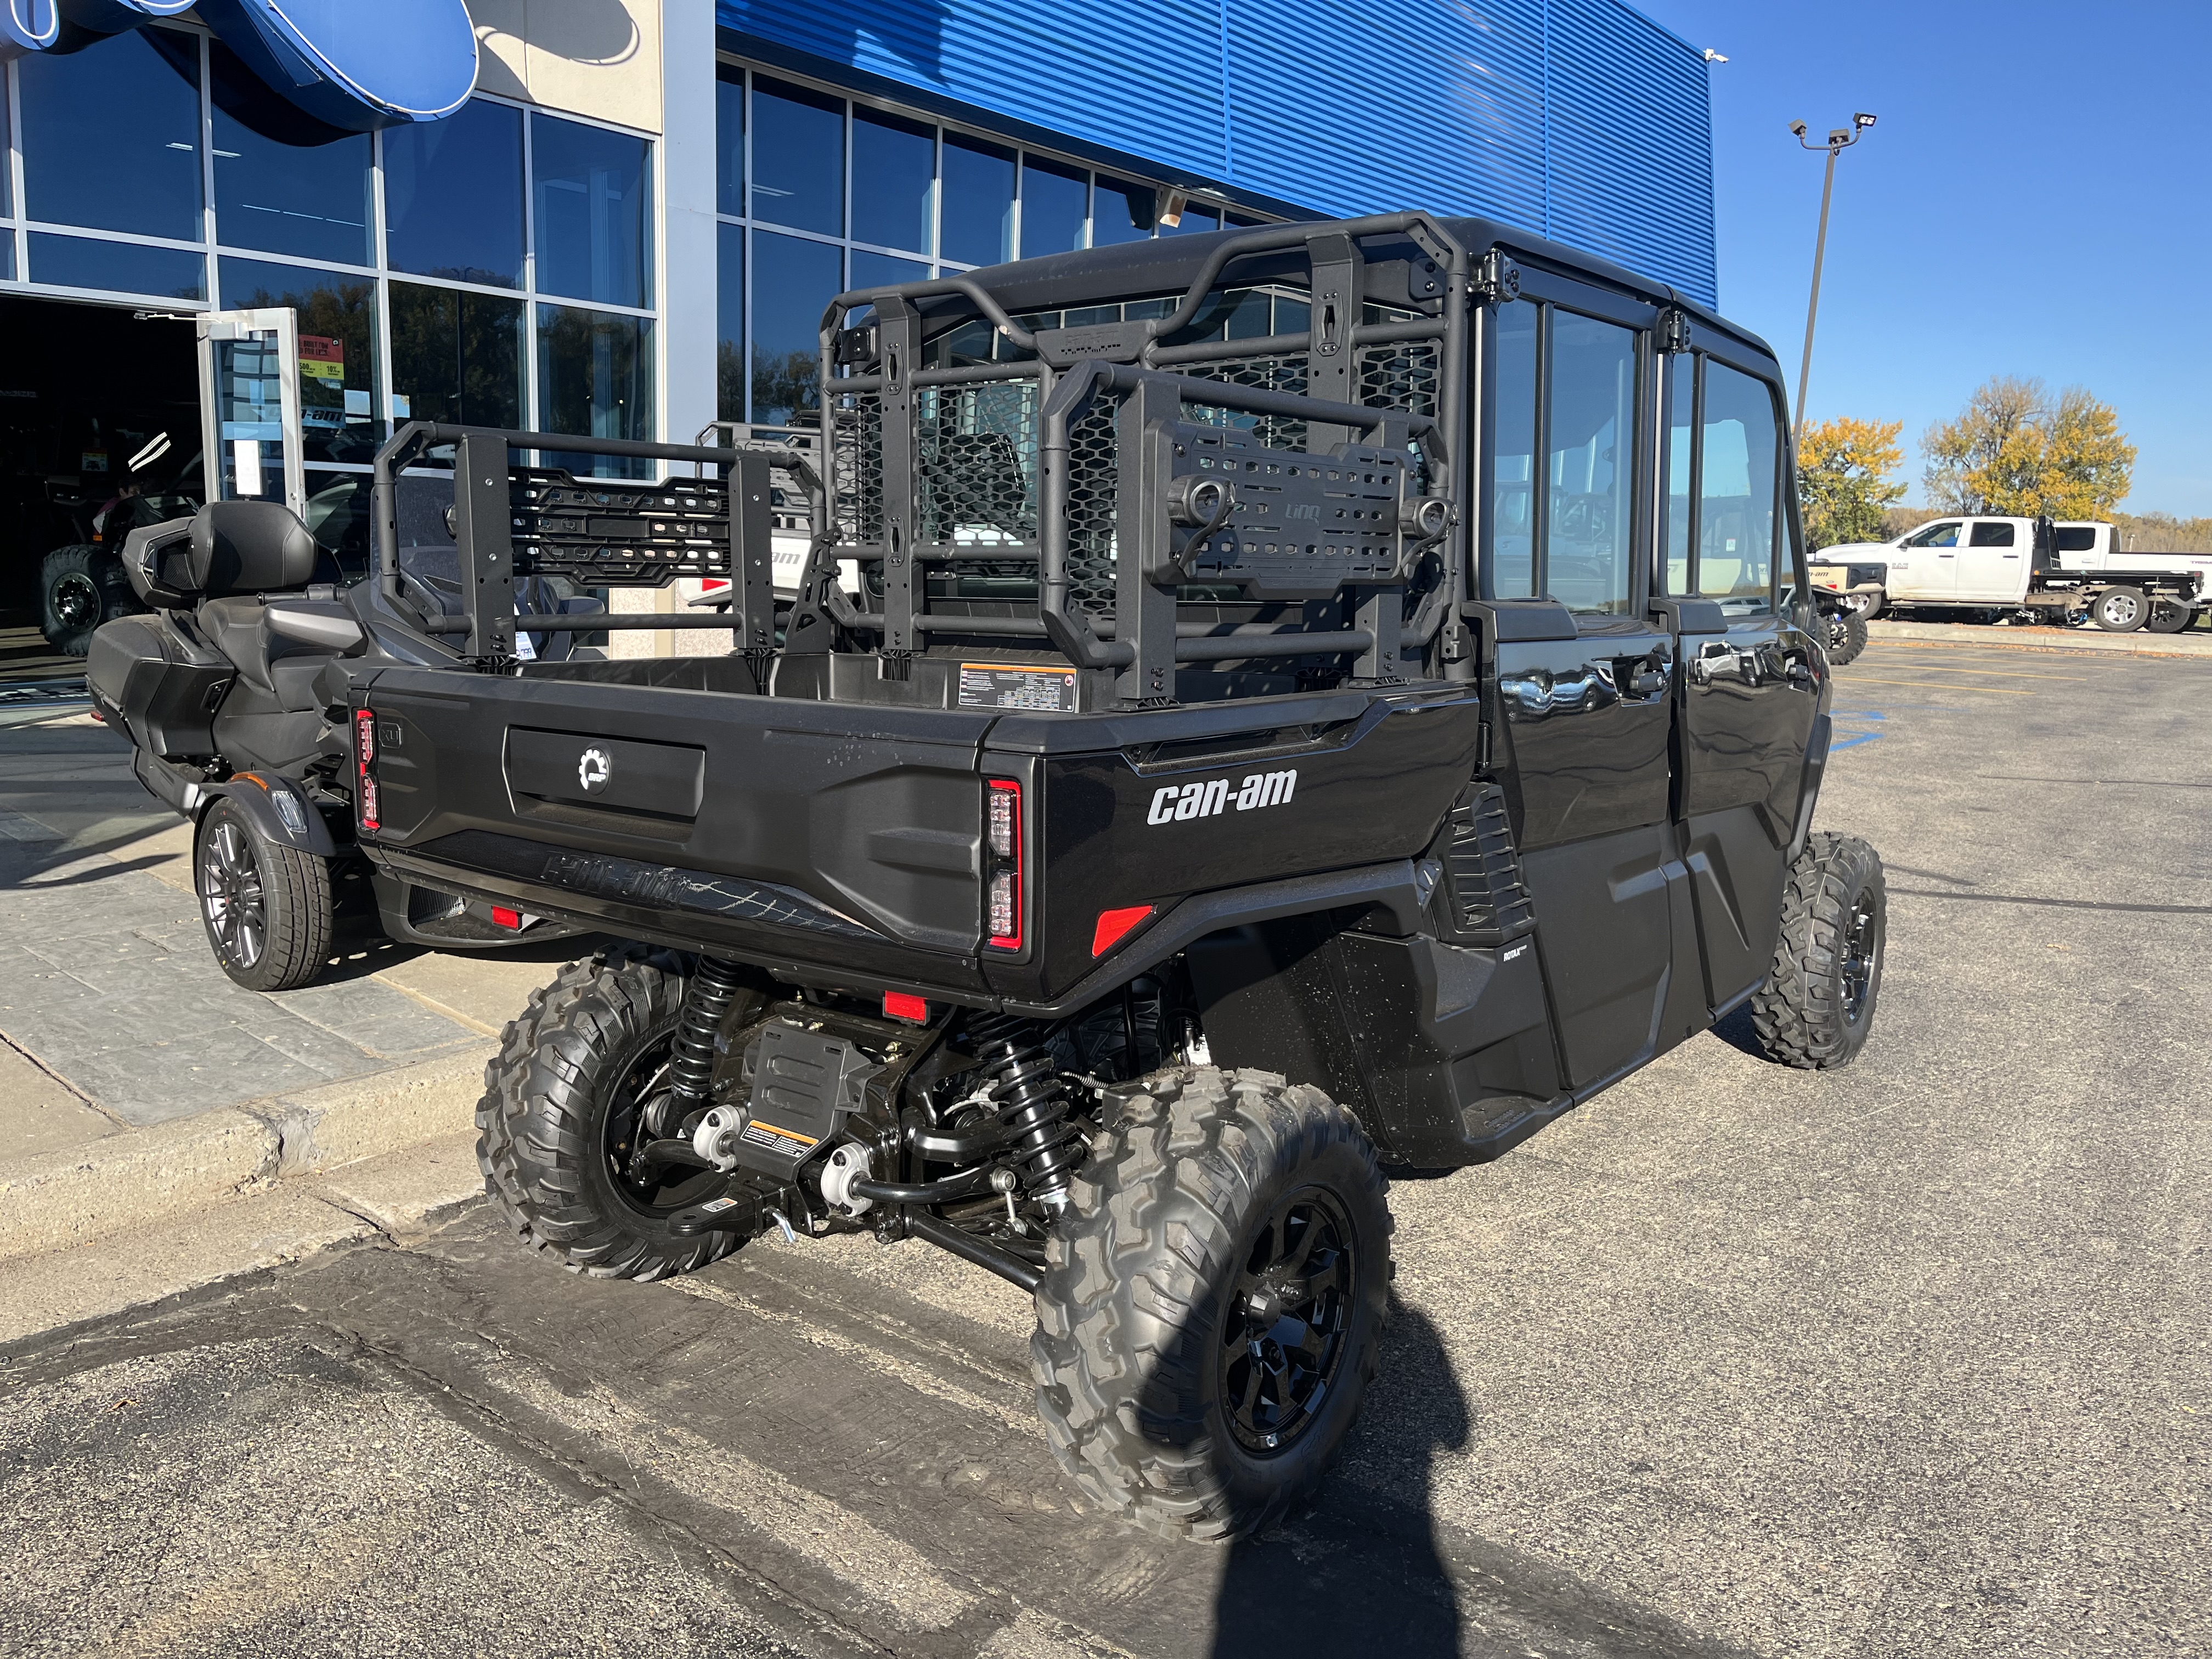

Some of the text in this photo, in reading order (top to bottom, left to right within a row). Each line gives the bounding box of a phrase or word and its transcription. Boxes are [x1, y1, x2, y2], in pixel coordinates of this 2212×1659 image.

[588, 772, 606, 782] BRP
[1146, 769, 1297, 825] can-am
[1503, 947, 1521, 962] ROTAX
[1147, 1257, 1184, 1280] XPS
